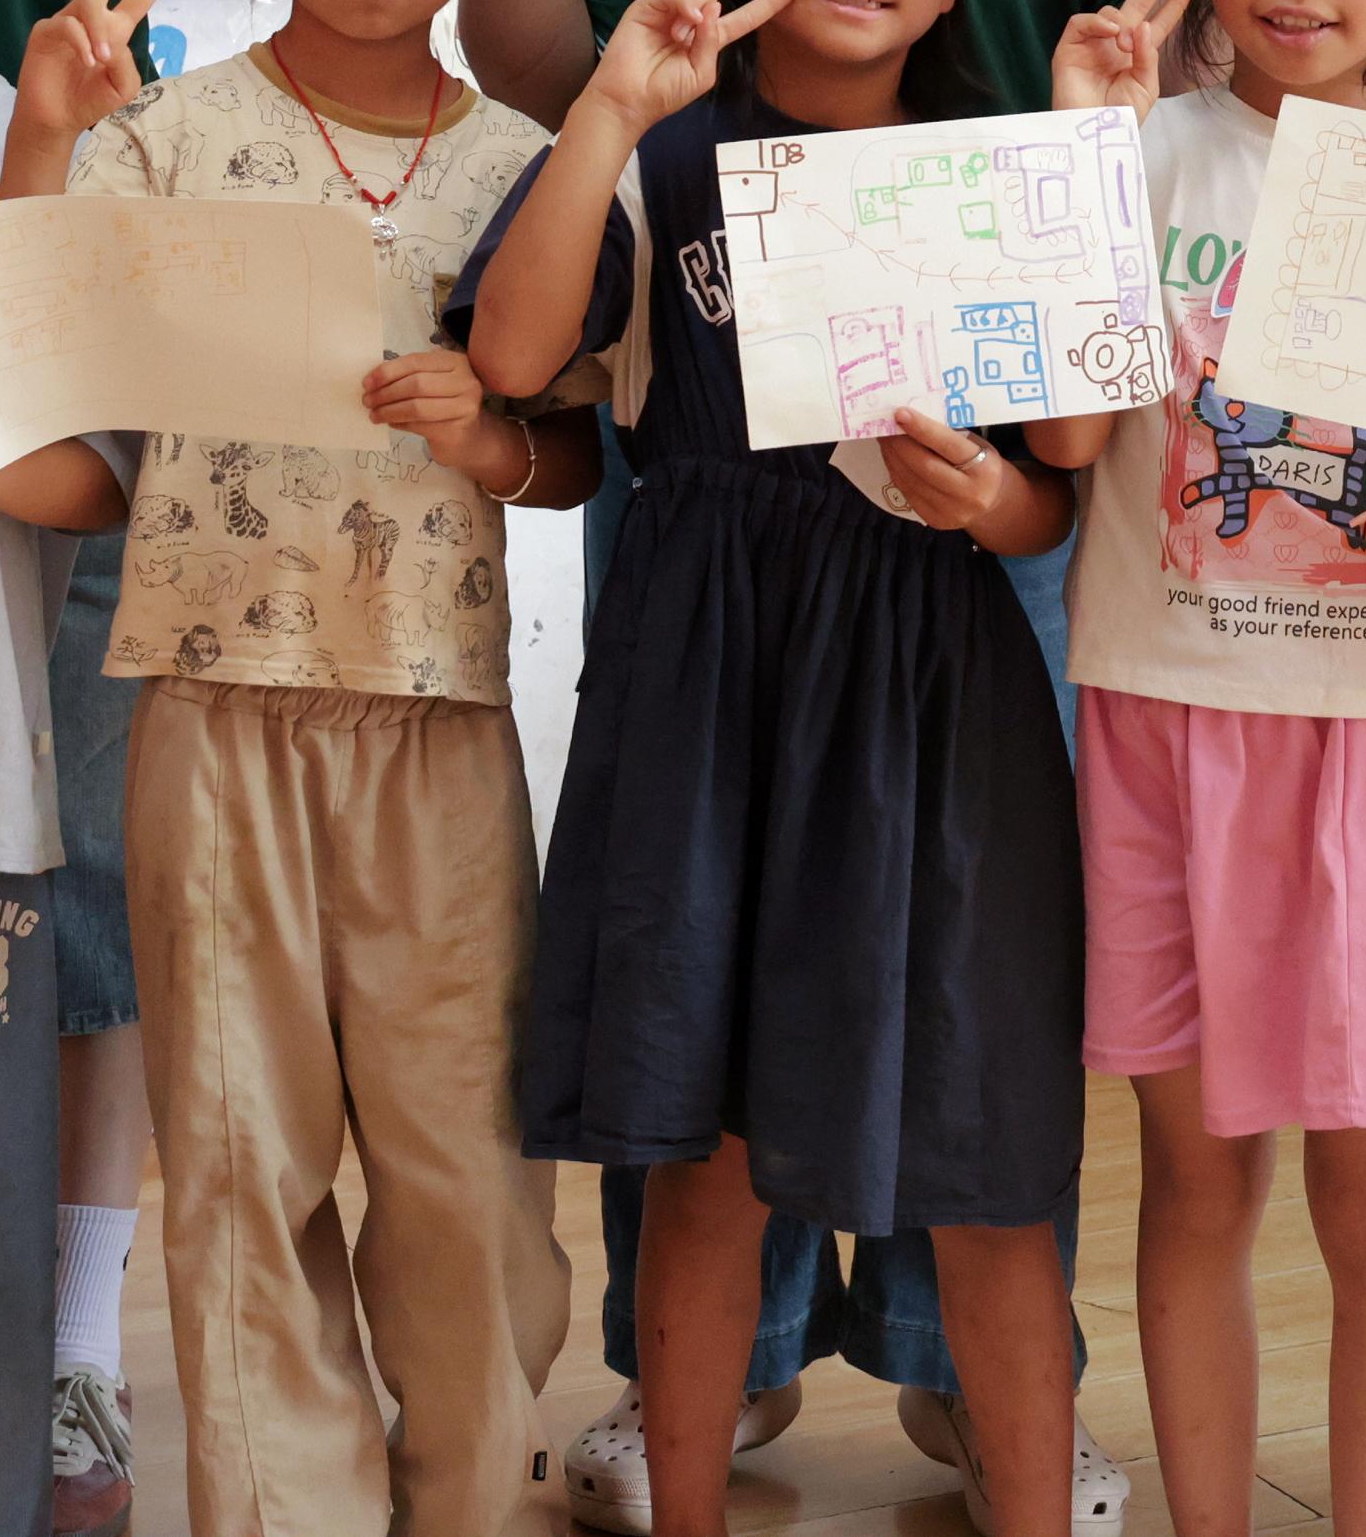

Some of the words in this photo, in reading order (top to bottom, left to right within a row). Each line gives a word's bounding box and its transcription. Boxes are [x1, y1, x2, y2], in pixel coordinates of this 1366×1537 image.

[1160, 225, 1244, 291] LO
[1167, 586, 1204, 608] your
[1208, 594, 1258, 615] good
[1264, 594, 1320, 618] friend
[1209, 617, 1229, 632] as
[1233, 617, 1277, 638] your
